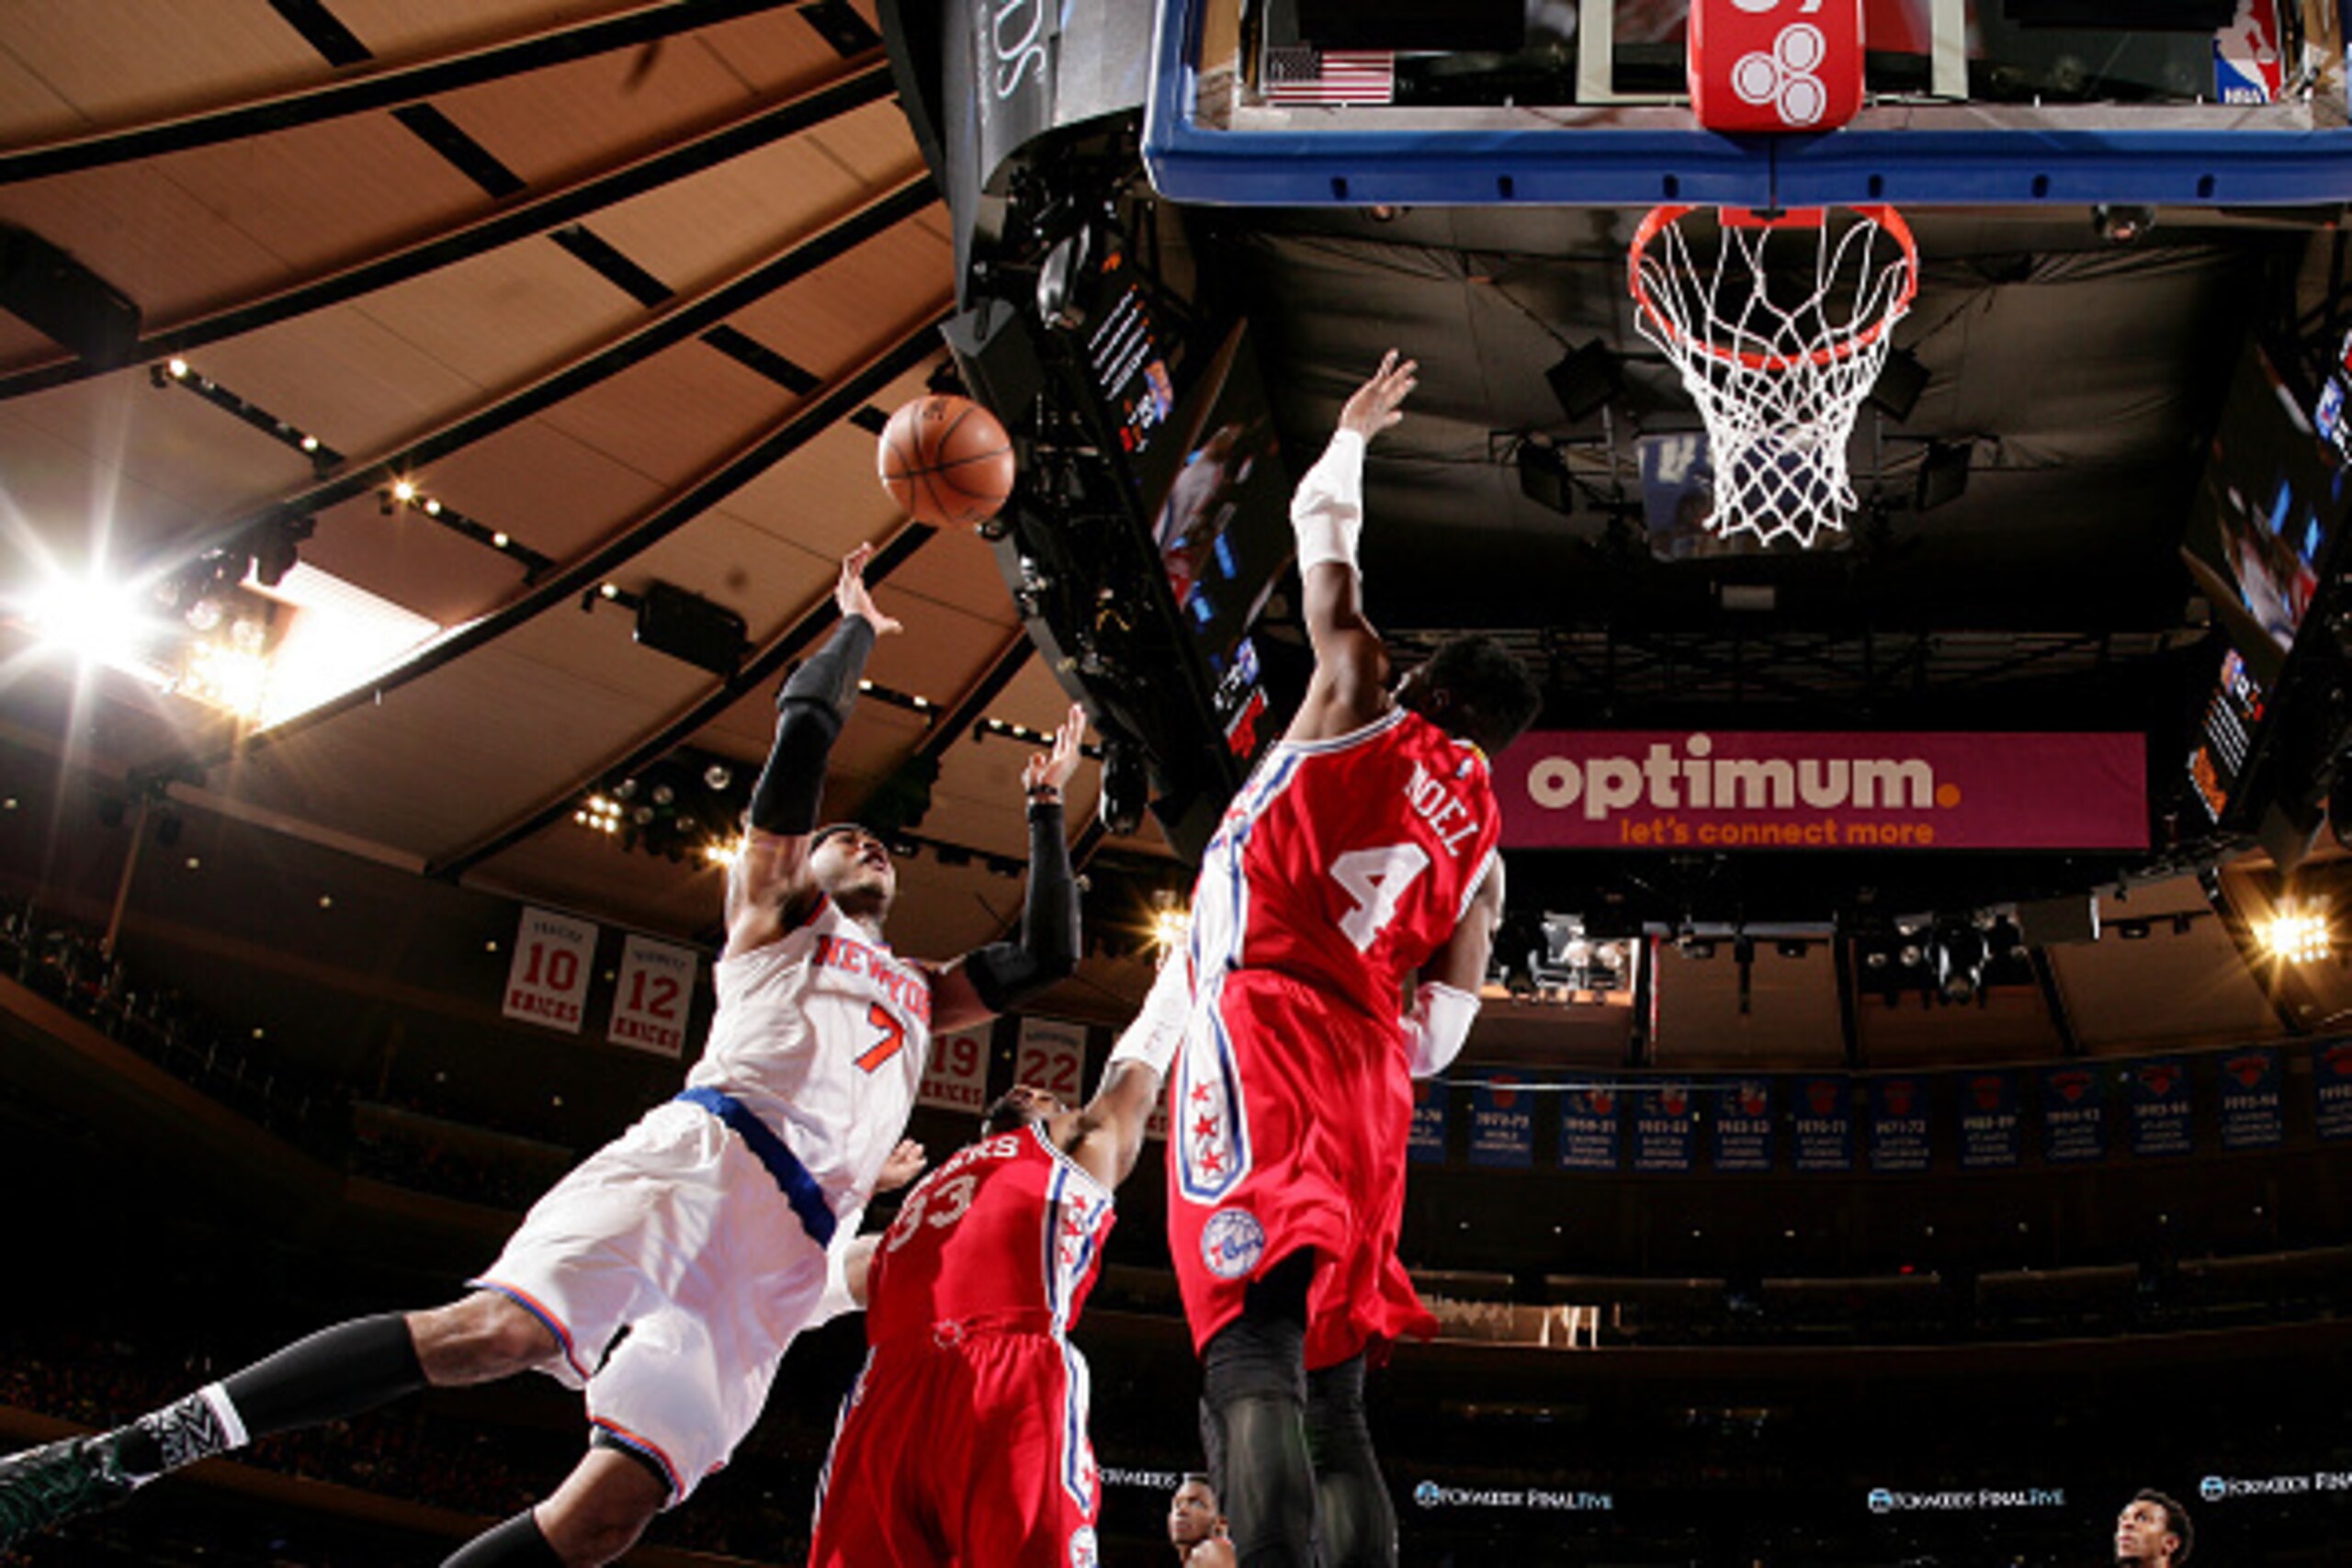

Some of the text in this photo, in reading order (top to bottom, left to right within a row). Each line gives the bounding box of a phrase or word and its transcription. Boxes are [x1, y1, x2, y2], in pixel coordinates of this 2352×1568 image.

[2224, 86, 2262, 105] NBA
[1404, 760, 1479, 858] NOEL
[1621, 818, 1934, 844] let's connect more
[1329, 842, 1430, 953] 4
[523, 942, 580, 992] 10
[627, 969, 681, 1021] 12
[853, 1000, 906, 1074] 7
[928, 1034, 979, 1078] 19
[1020, 1049, 1079, 1094] 22
[886, 1174, 978, 1253] 33
